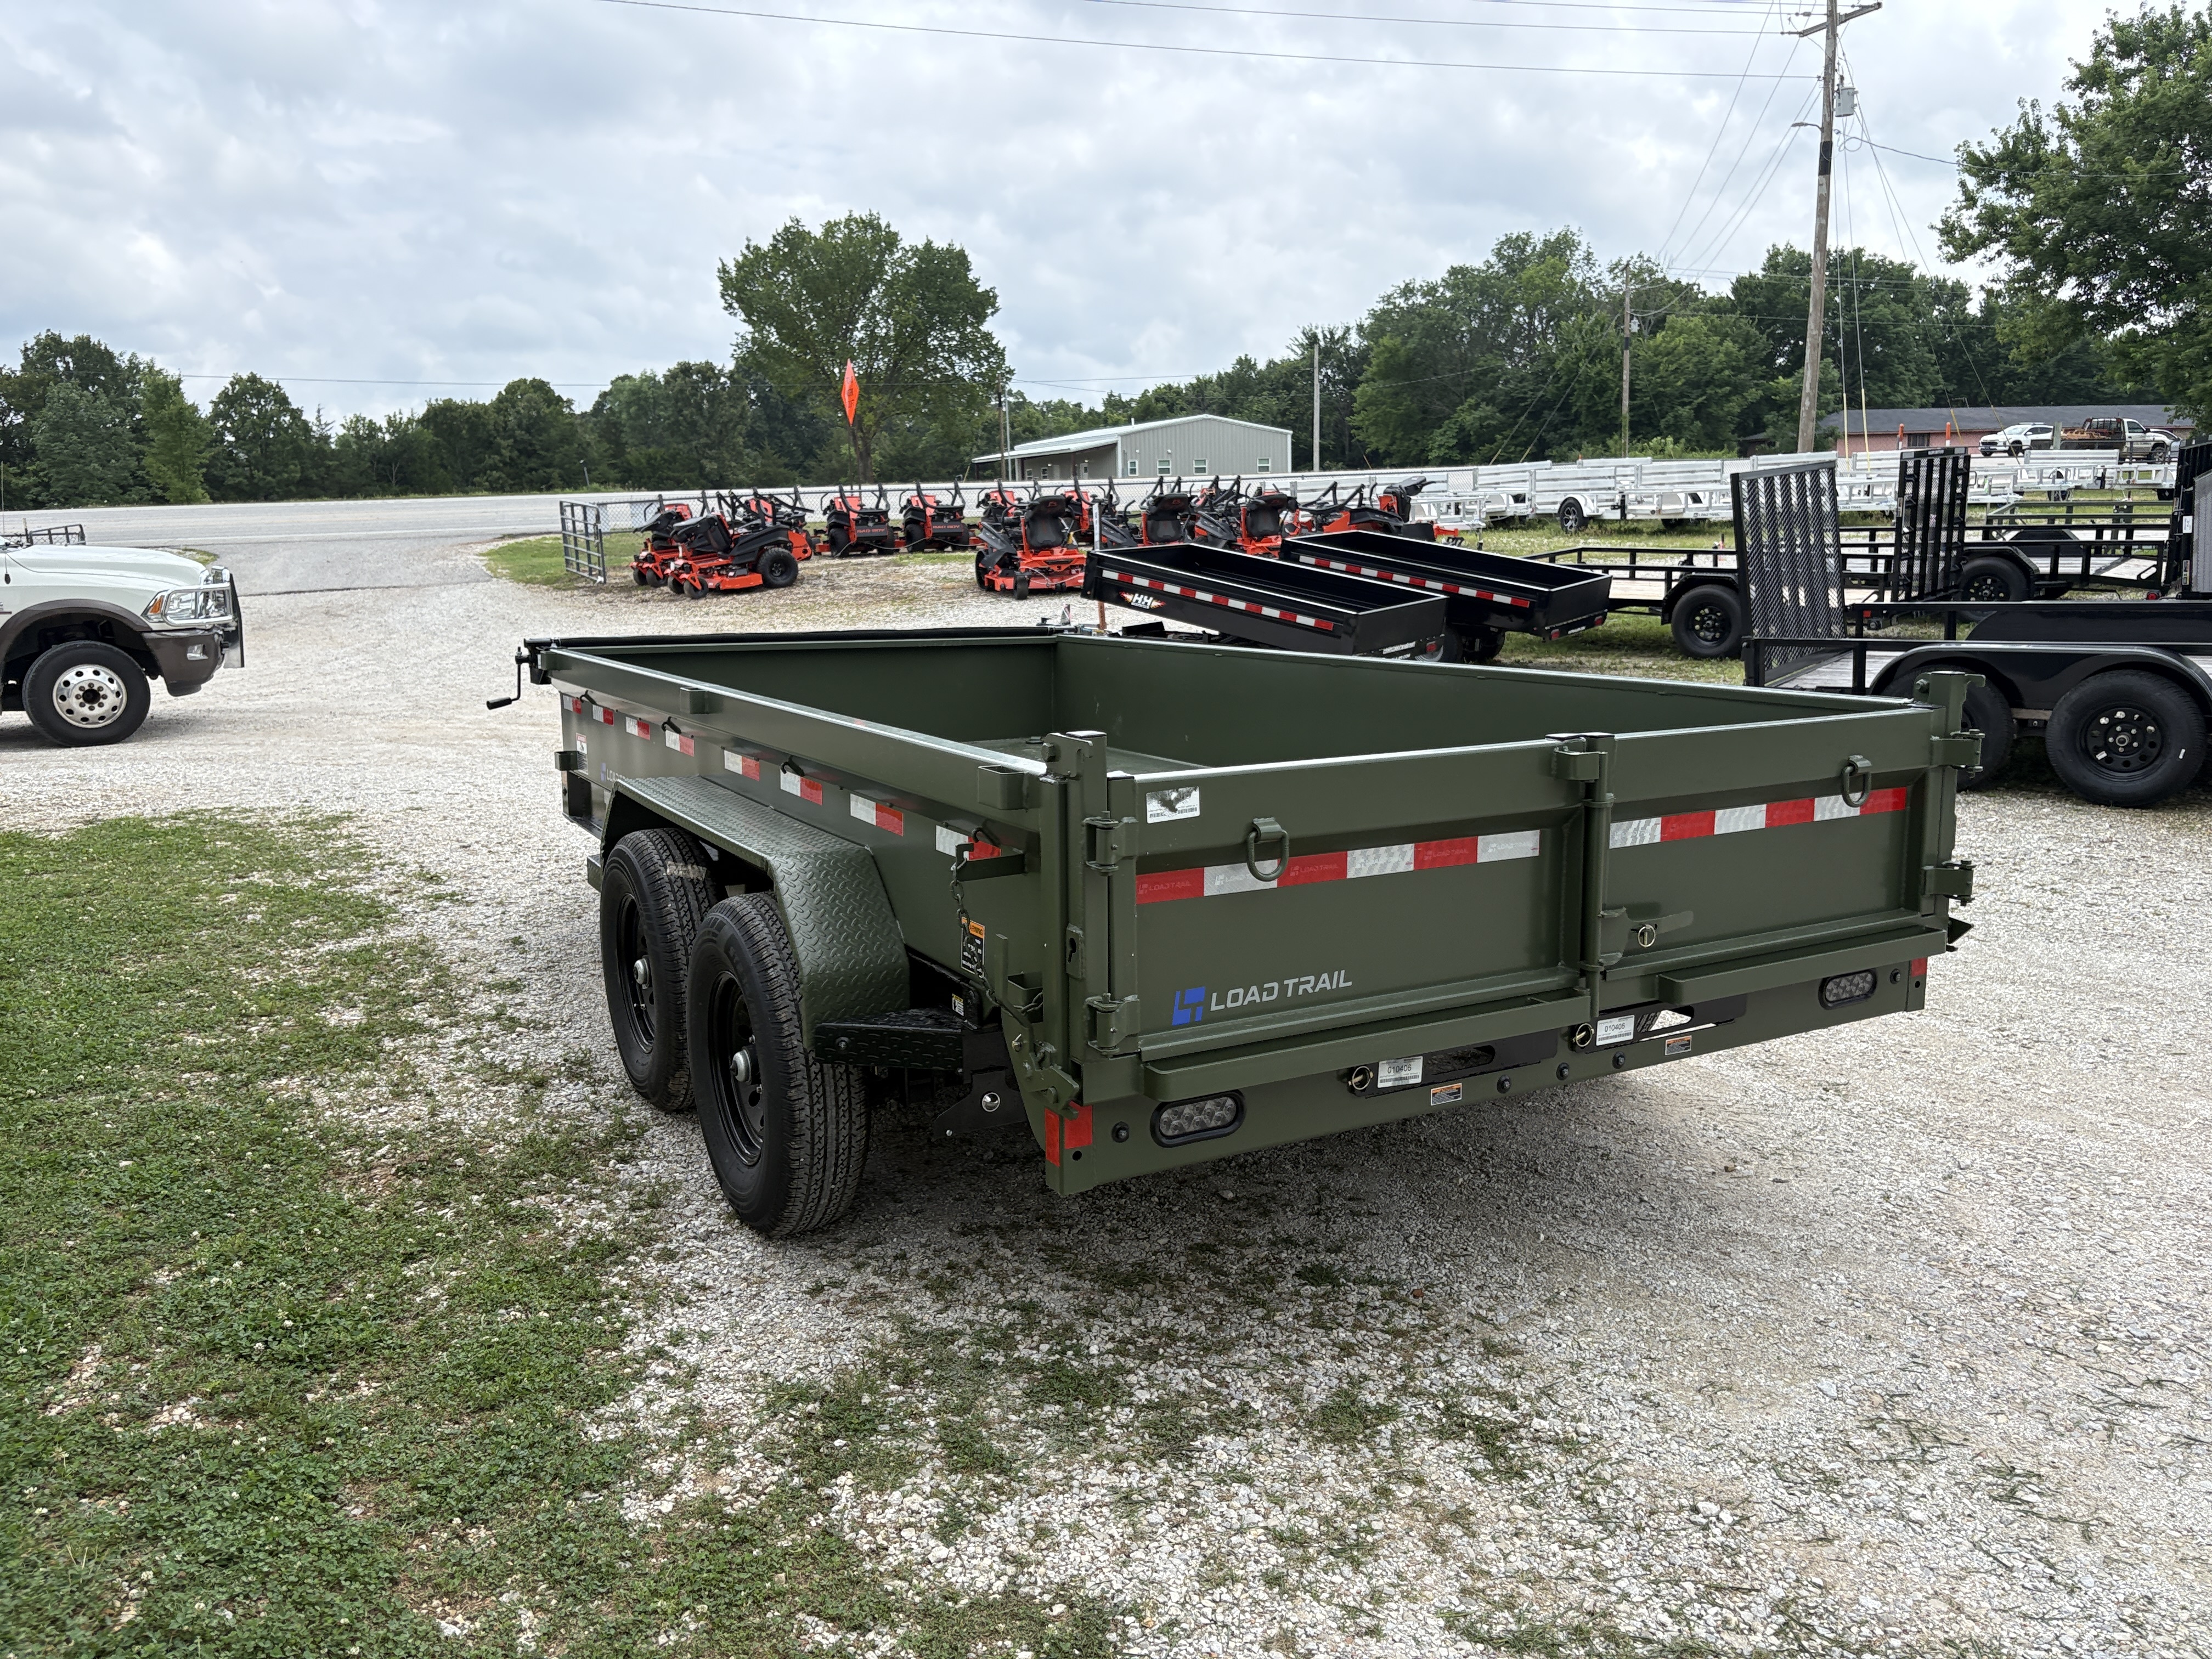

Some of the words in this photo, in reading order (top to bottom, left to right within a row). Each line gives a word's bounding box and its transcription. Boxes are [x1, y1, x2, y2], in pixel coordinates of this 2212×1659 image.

[1210, 984, 1279, 1012] LOAD
[1283, 969, 1352, 997] TRAIL
[1604, 1022, 1626, 1032] 010406
[1387, 1064, 1412, 1074] 010406
